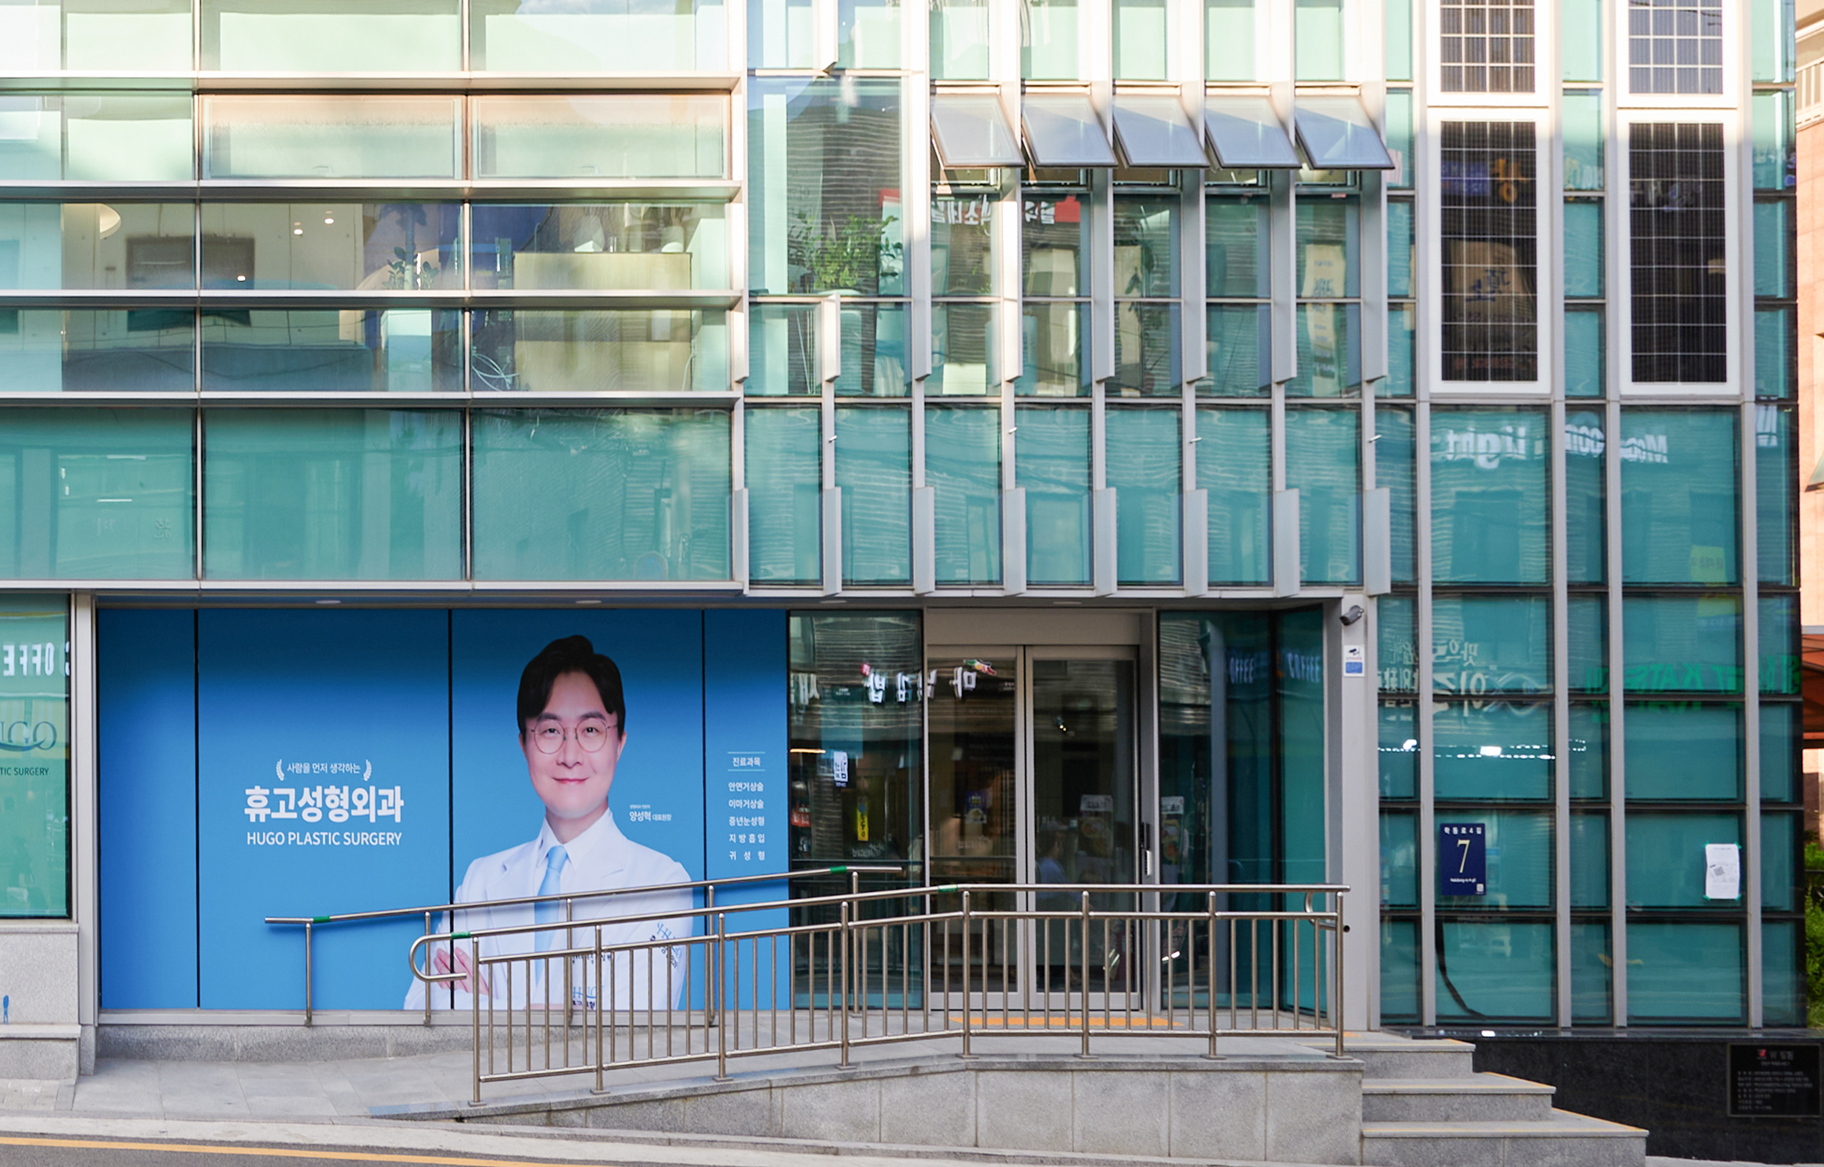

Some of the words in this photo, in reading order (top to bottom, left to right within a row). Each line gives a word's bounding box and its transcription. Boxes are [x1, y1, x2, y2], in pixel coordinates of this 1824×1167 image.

[287, 762, 310, 774] 사람을
[312, 762, 328, 774] 먼저
[330, 762, 361, 774] 생각하는
[732, 757, 761, 767] 진료과목
[13, 766, 49, 776] SURGERY
[244, 785, 404, 823] 휴고성형외과
[247, 831, 285, 846] HUGO
[288, 831, 340, 846] PLASTIC
[343, 831, 402, 846] SURGERY
[1457, 839, 1471, 874] 7
